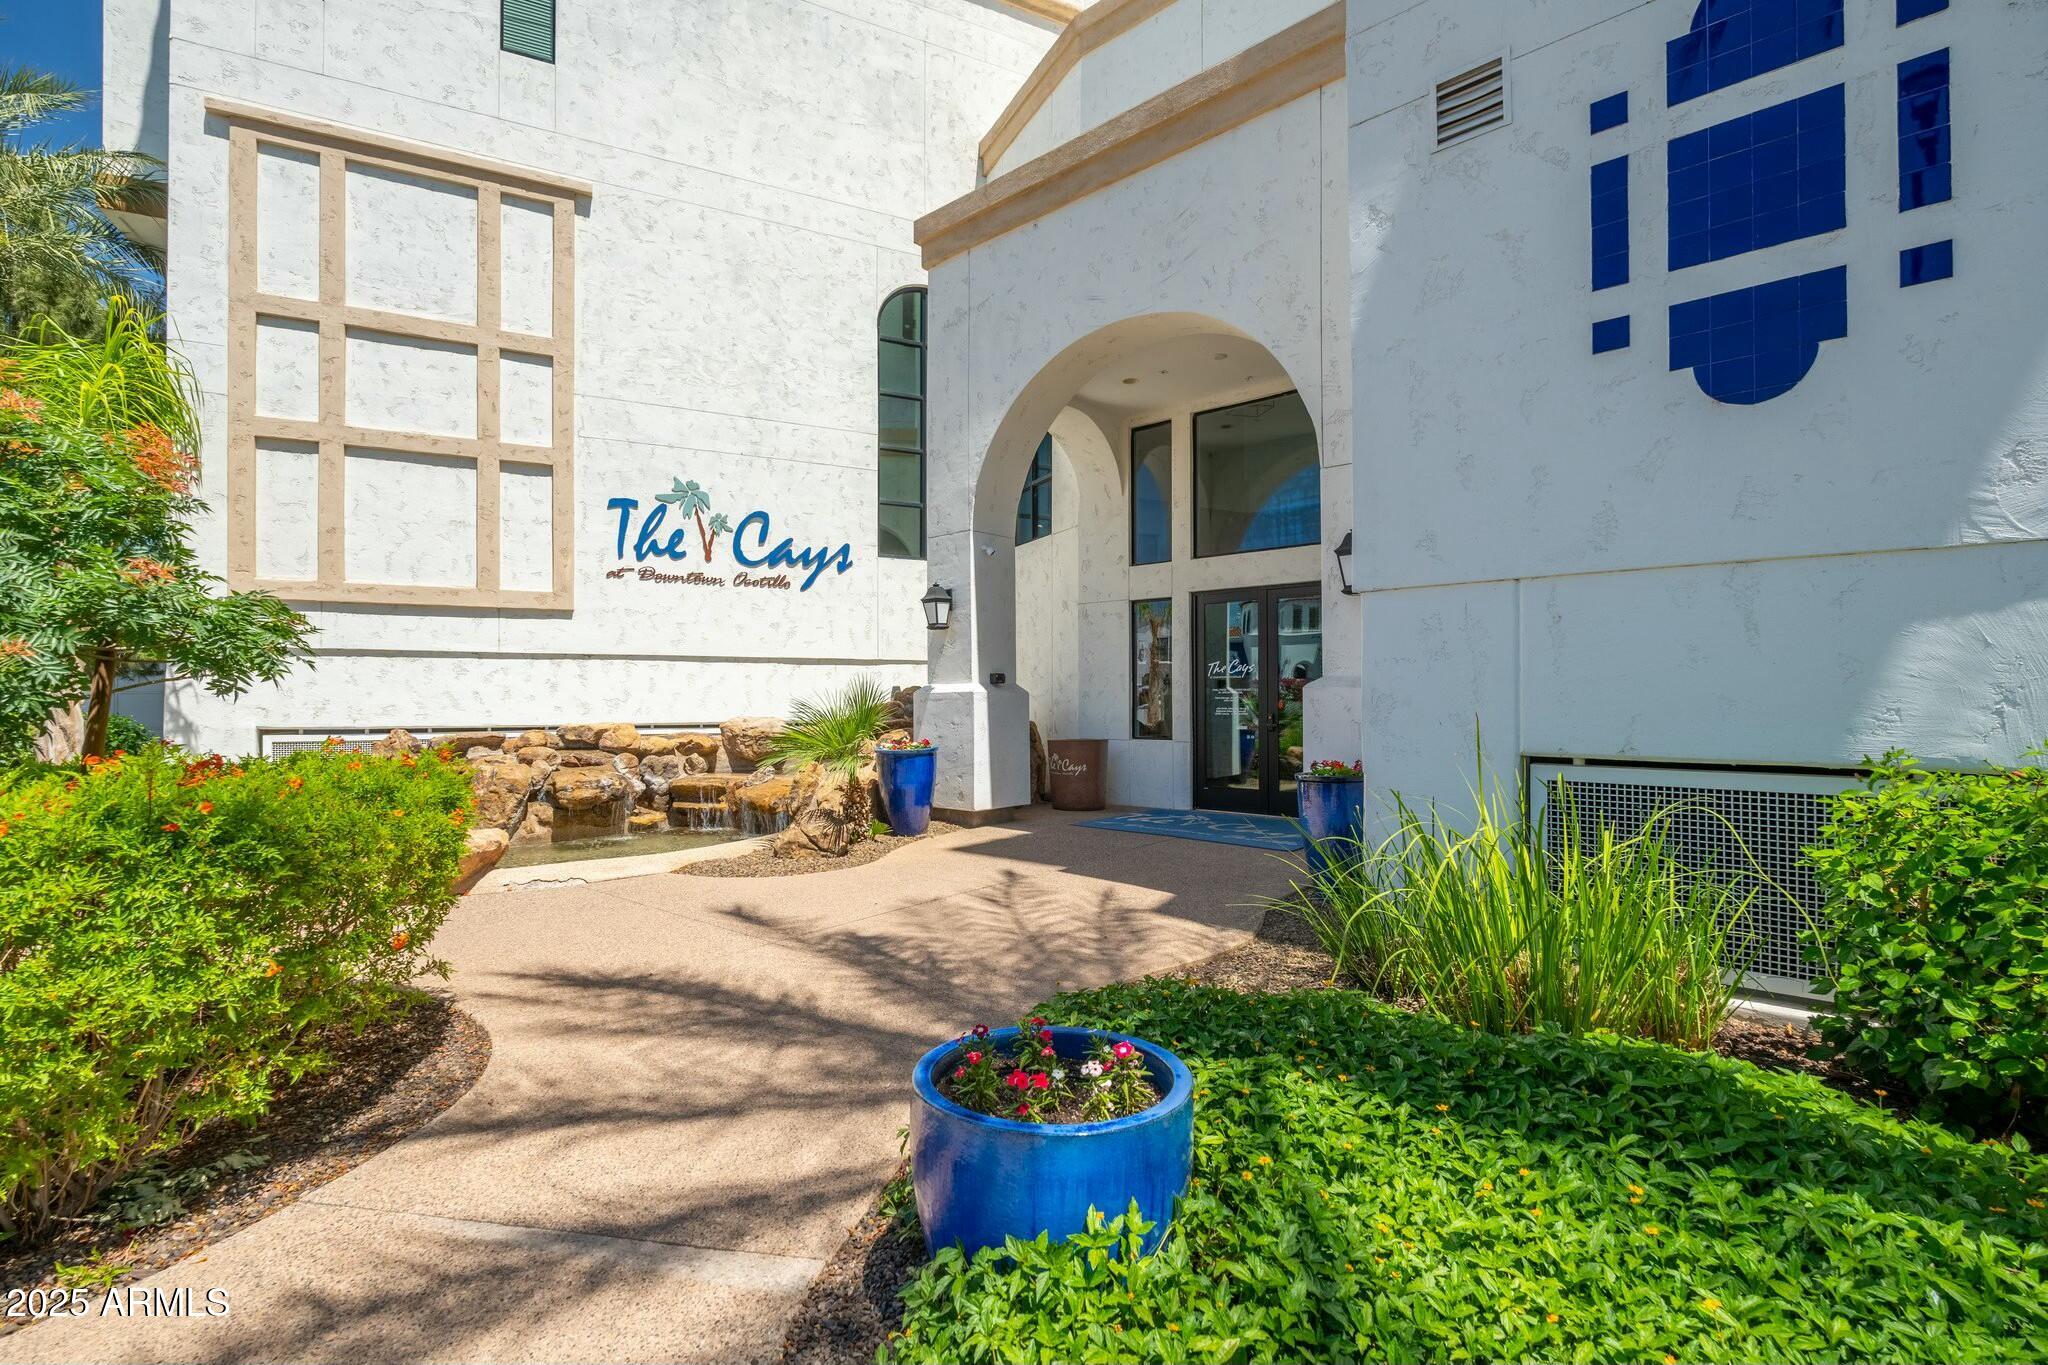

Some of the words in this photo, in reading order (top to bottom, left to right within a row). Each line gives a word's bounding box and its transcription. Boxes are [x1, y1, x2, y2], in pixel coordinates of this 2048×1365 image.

[607, 497, 687, 562] The
[732, 510, 853, 592] Cays
[605, 566, 635, 580] at
[637, 565, 726, 587] Downtown
[732, 571, 792, 591] Ocotillo
[1207, 660, 1227, 677] The
[1228, 658, 1257, 678] Cays
[1061, 758, 1087, 777] Cays
